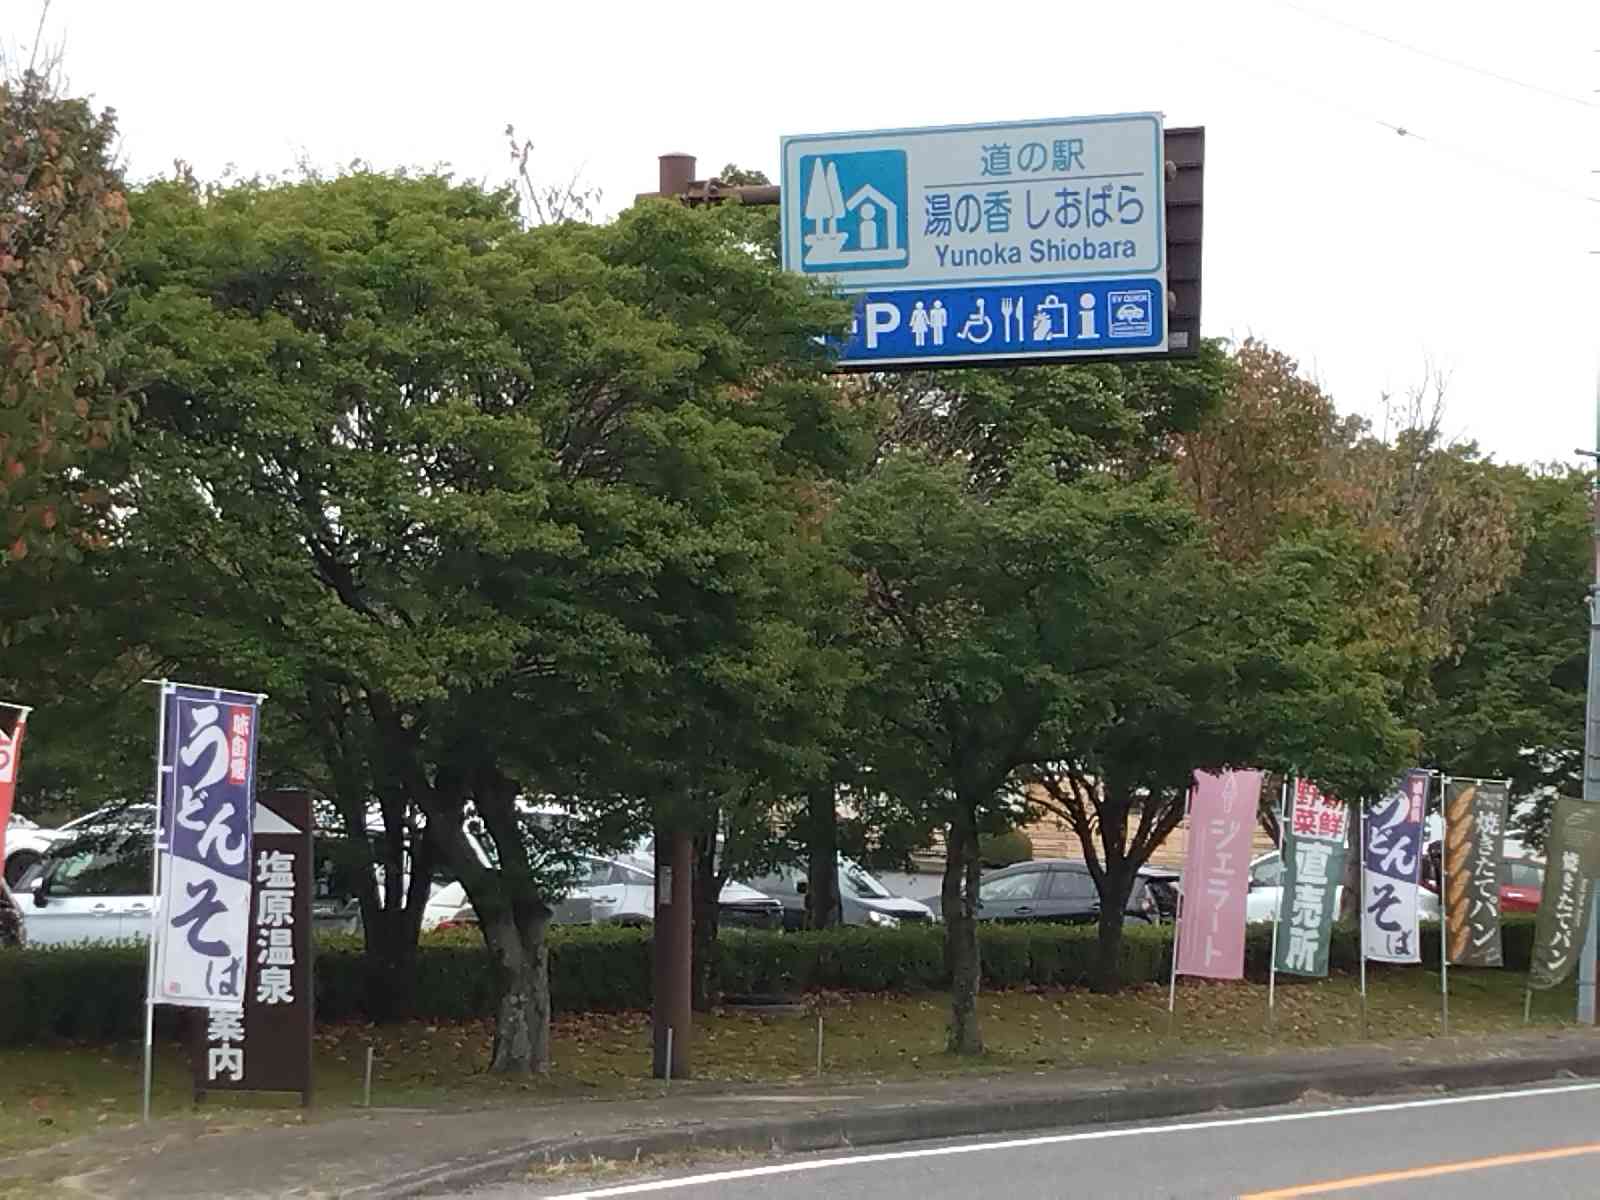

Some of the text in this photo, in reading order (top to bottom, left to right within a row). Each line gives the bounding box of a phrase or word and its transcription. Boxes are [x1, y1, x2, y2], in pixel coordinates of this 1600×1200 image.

[923, 182, 1145, 238] 湯の香 しおばら
[980, 137, 1086, 177] 道の駅
[934, 236, 1137, 268] Yunoka Shiobara
[866, 303, 901, 349] P
[178, 704, 247, 867] うどん
[170, 878, 242, 997] そば
[256, 850, 296, 1004] 塩原温泉
[1204, 819, 1242, 967] ジェラート
[1285, 841, 1334, 974] 直売所
[1367, 883, 1412, 956] そば
[1469, 810, 1500, 947] 焼きたてパン
[1548, 850, 1580, 970] 焼きたてパン
[207, 1005, 245, 1081] 案内
